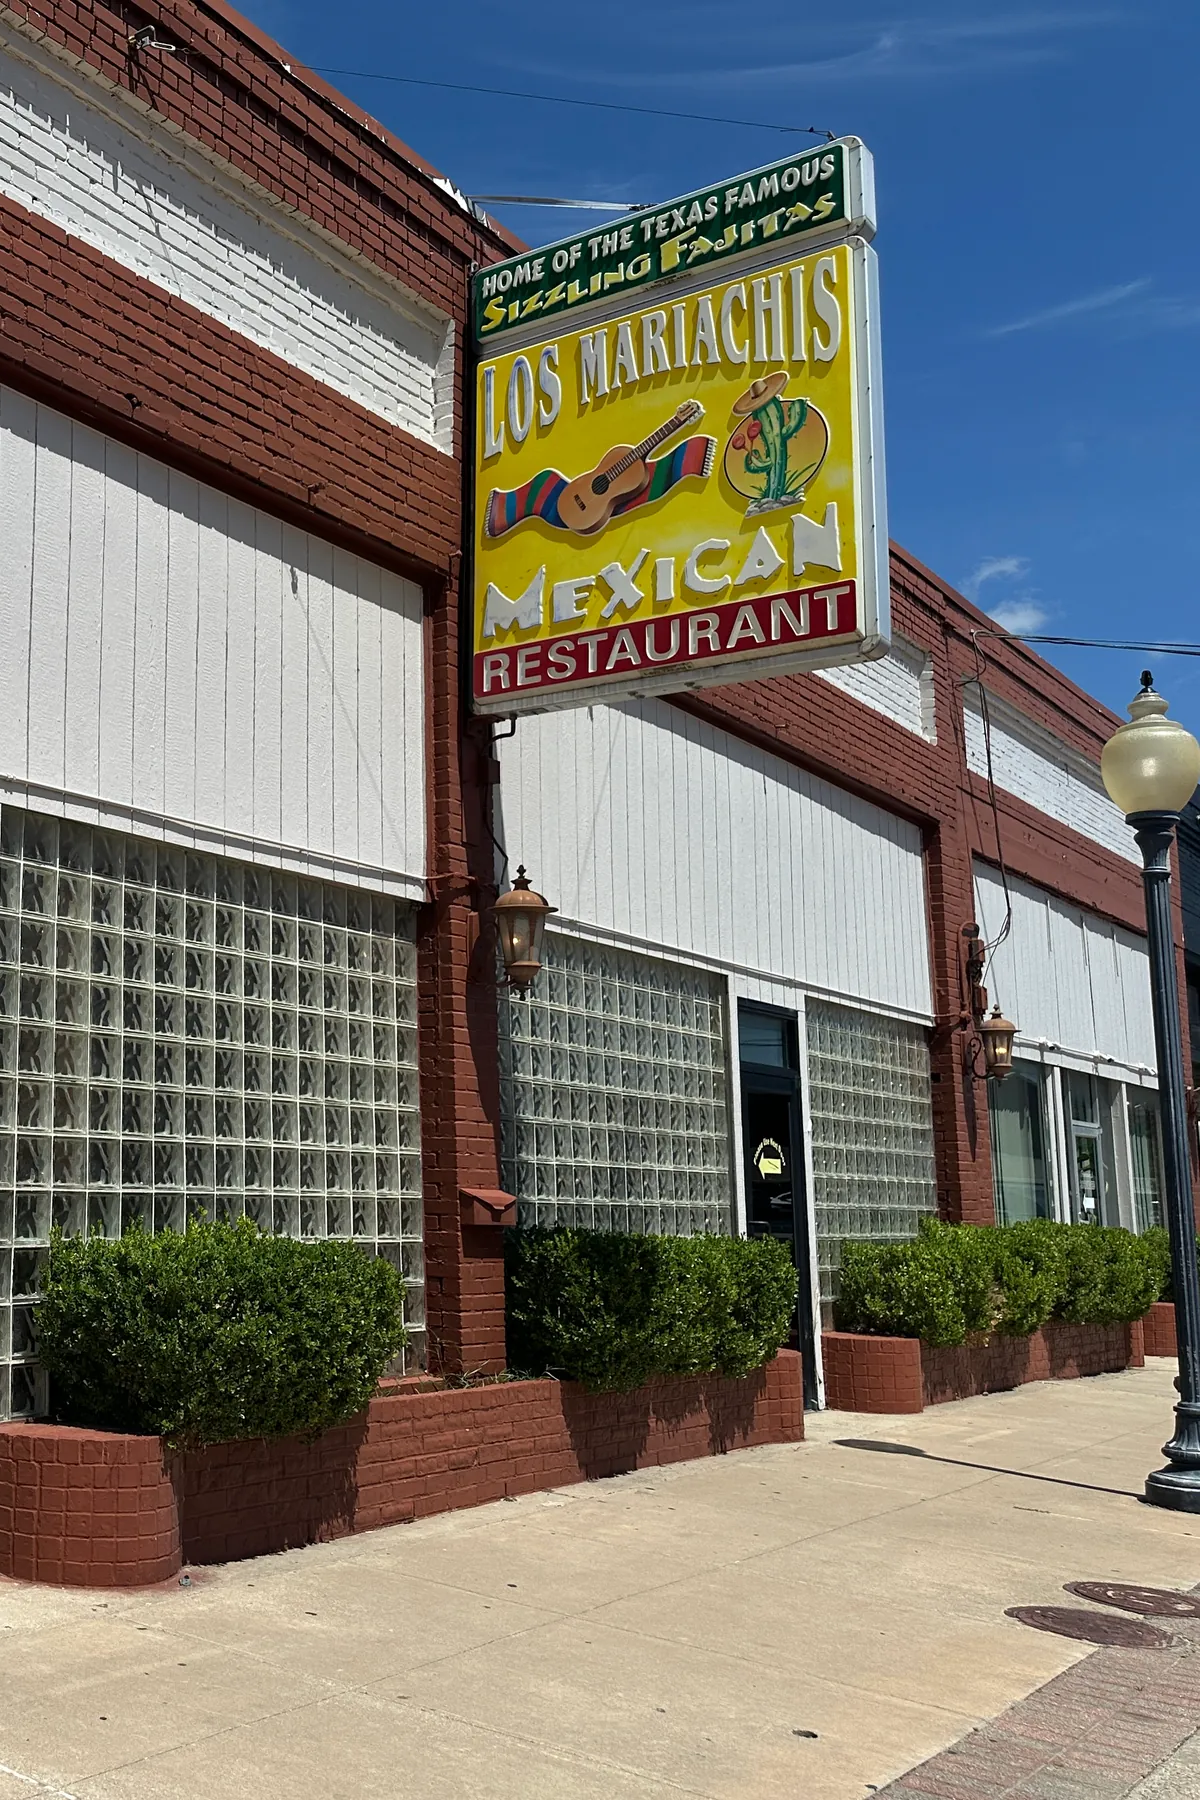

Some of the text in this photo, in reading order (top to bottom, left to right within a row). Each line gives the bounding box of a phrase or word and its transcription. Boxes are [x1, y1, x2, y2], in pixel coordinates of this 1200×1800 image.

[480, 192, 837, 332] SIZZLING FAJITAS
[482, 153, 836, 298] HOME OF THE TEXAS FAMOUS
[482, 256, 842, 460] LOS MARIACHIS
[482, 502, 843, 638] MEXICAN
[482, 585, 851, 692] RESTAURANT
